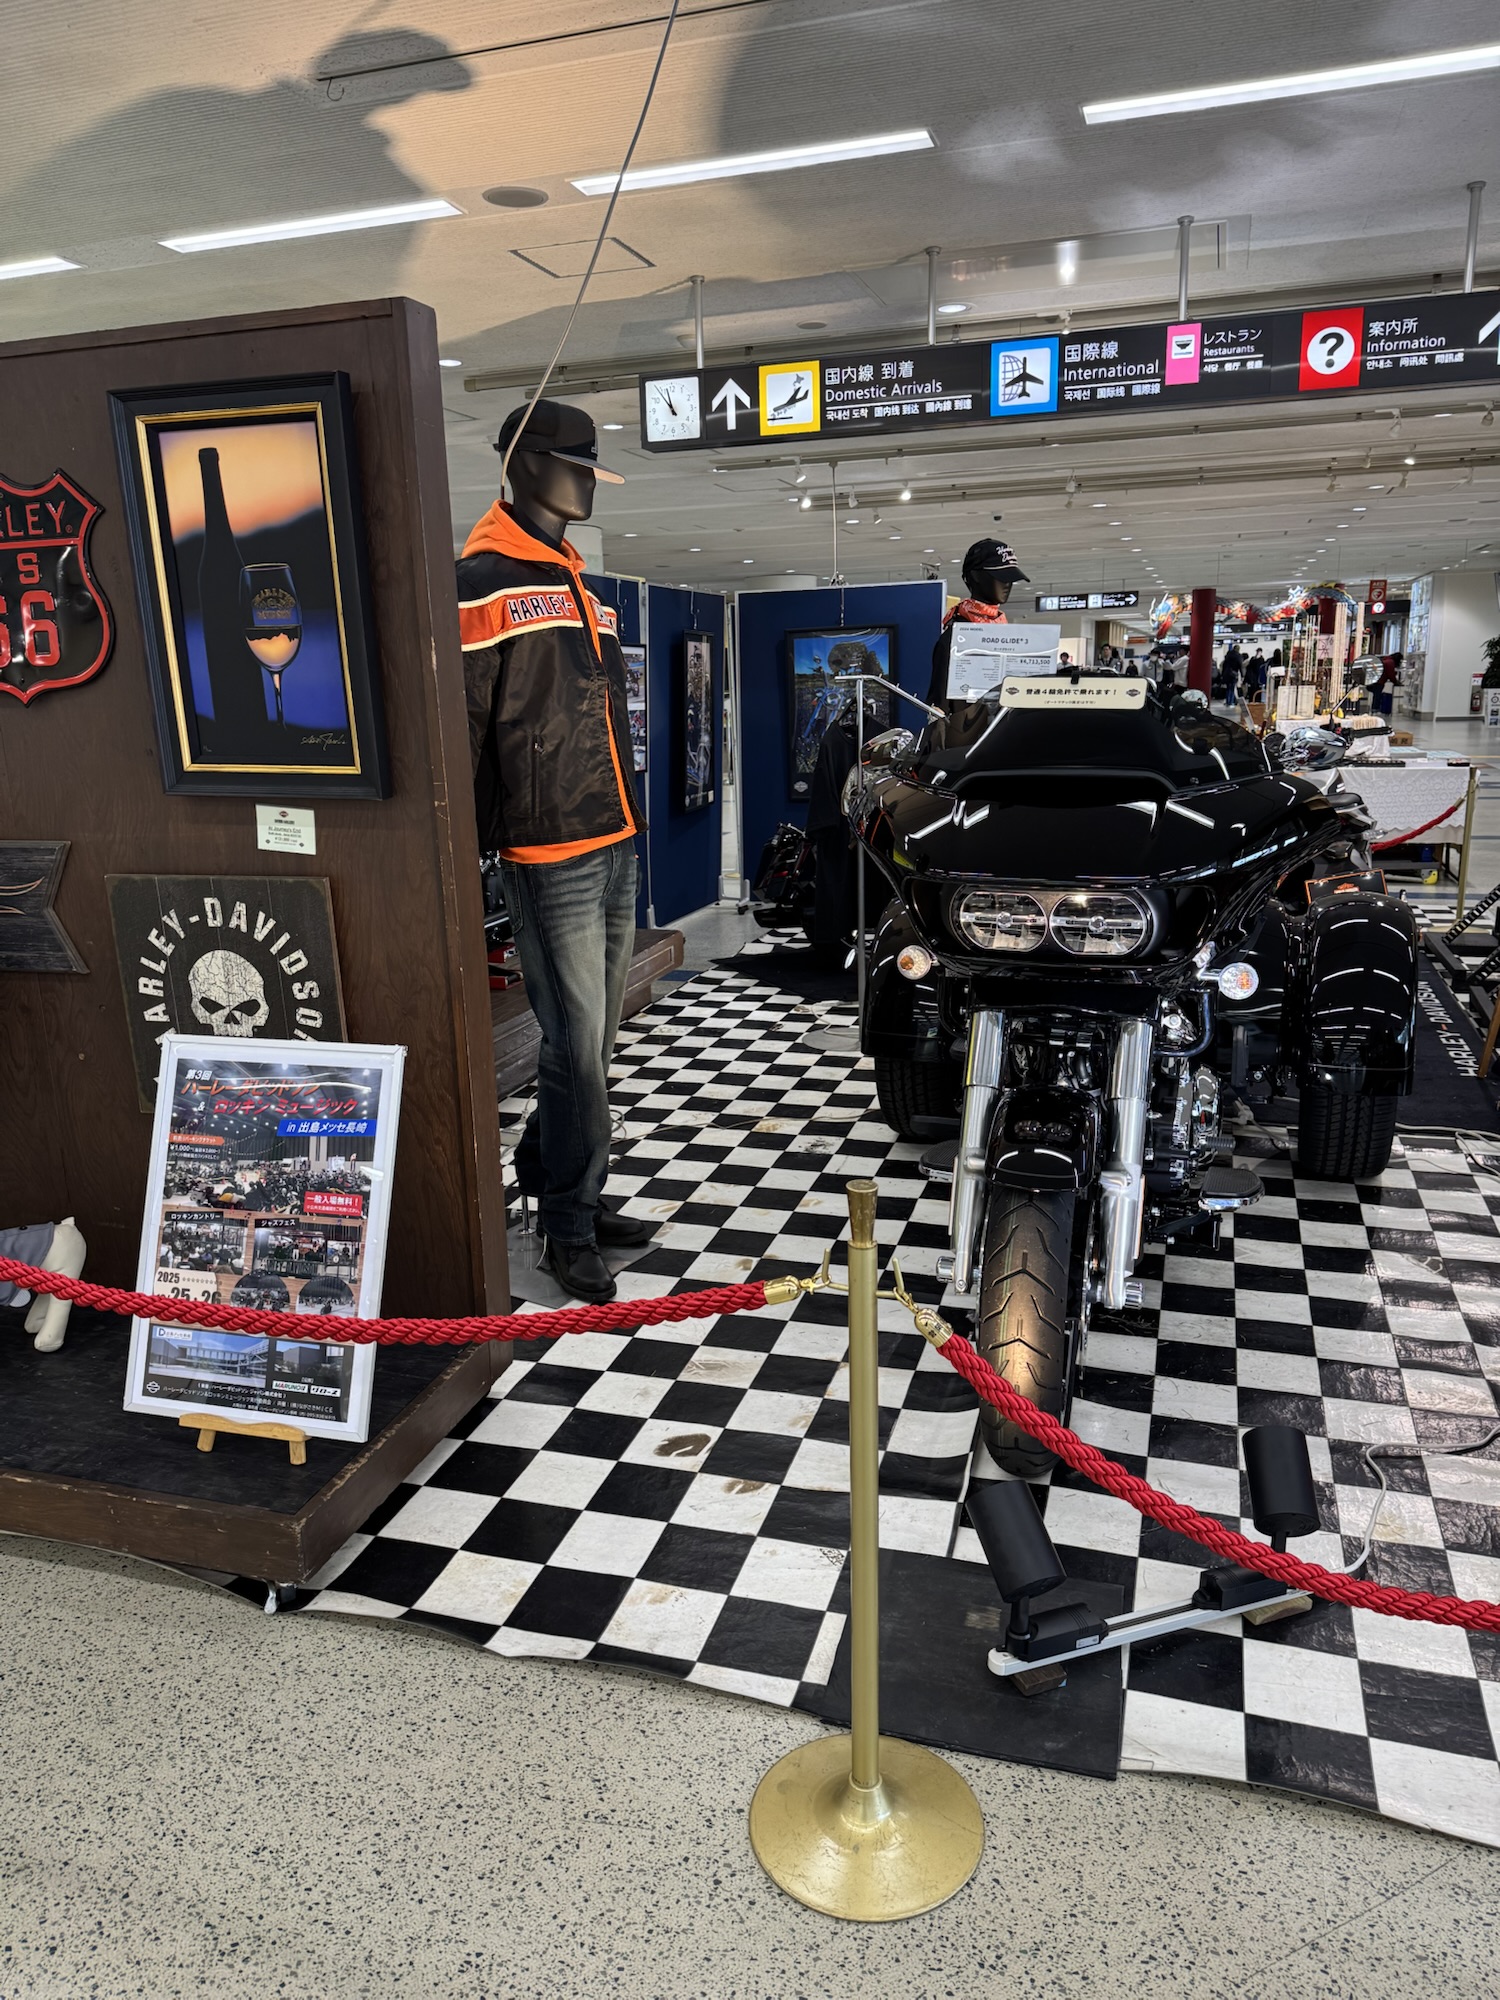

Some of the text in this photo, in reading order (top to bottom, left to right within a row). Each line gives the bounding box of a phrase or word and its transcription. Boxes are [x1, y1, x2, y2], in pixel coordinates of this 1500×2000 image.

[1368, 317, 1418, 337] 案内所
[1204, 329, 1262, 345] レストラン
[1366, 335, 1446, 352] Information
[1065, 341, 1118, 362] 国際線
[1203, 345, 1255, 356] Restaurants
[825, 360, 914, 385] 国内線 到着
[1064, 358, 1159, 381] International
[1366, 359, 1393, 370] 안내소
[669, 385, 676, 393] 12
[825, 379, 942, 402] Domestic Arrivals
[1064, 389, 1091, 401] 국제선
[825, 409, 850, 421] 국내선
[852, 407, 869, 419] 도착
[874, 405, 900, 417] 国内线
[0, 500, 66, 538] LEY
[17, 552, 40, 585] S
[507, 594, 574, 624] HARLEY-
[0, 589, 61, 667] 6
[185, 1069, 212, 1080] 第3回
[197, 1102, 206, 1112] &
[286, 1122, 368, 1134] in 出島メッセ長崎
[260, 1219, 296, 1227] ジャズフェス
[157, 1271, 180, 1284] 2025
